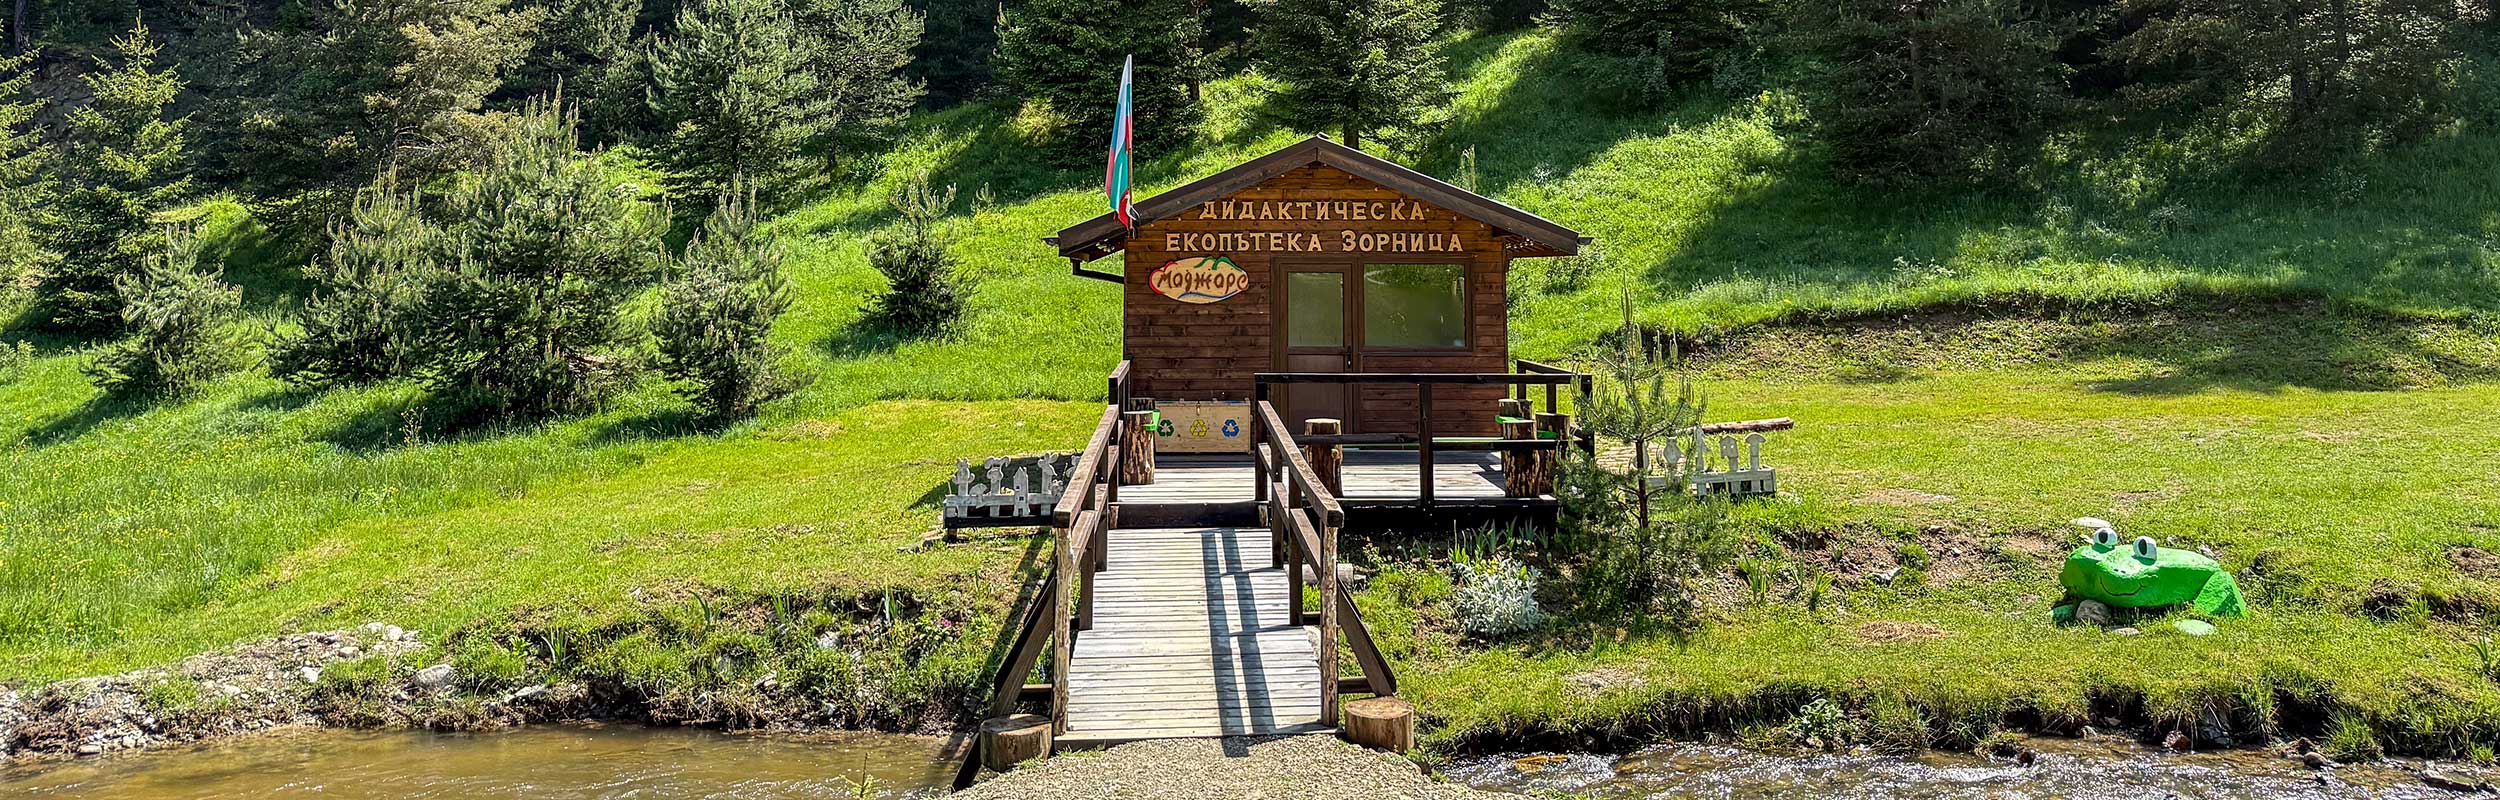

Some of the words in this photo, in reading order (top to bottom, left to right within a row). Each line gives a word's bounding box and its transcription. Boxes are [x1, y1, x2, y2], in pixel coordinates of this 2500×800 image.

[1199, 200, 1425, 220] ДИДАКТИЧЕСКА
[1165, 232, 1323, 252] ЕКОПЪТЕКА
[1341, 230, 1464, 252] ЗОРНИЦА
